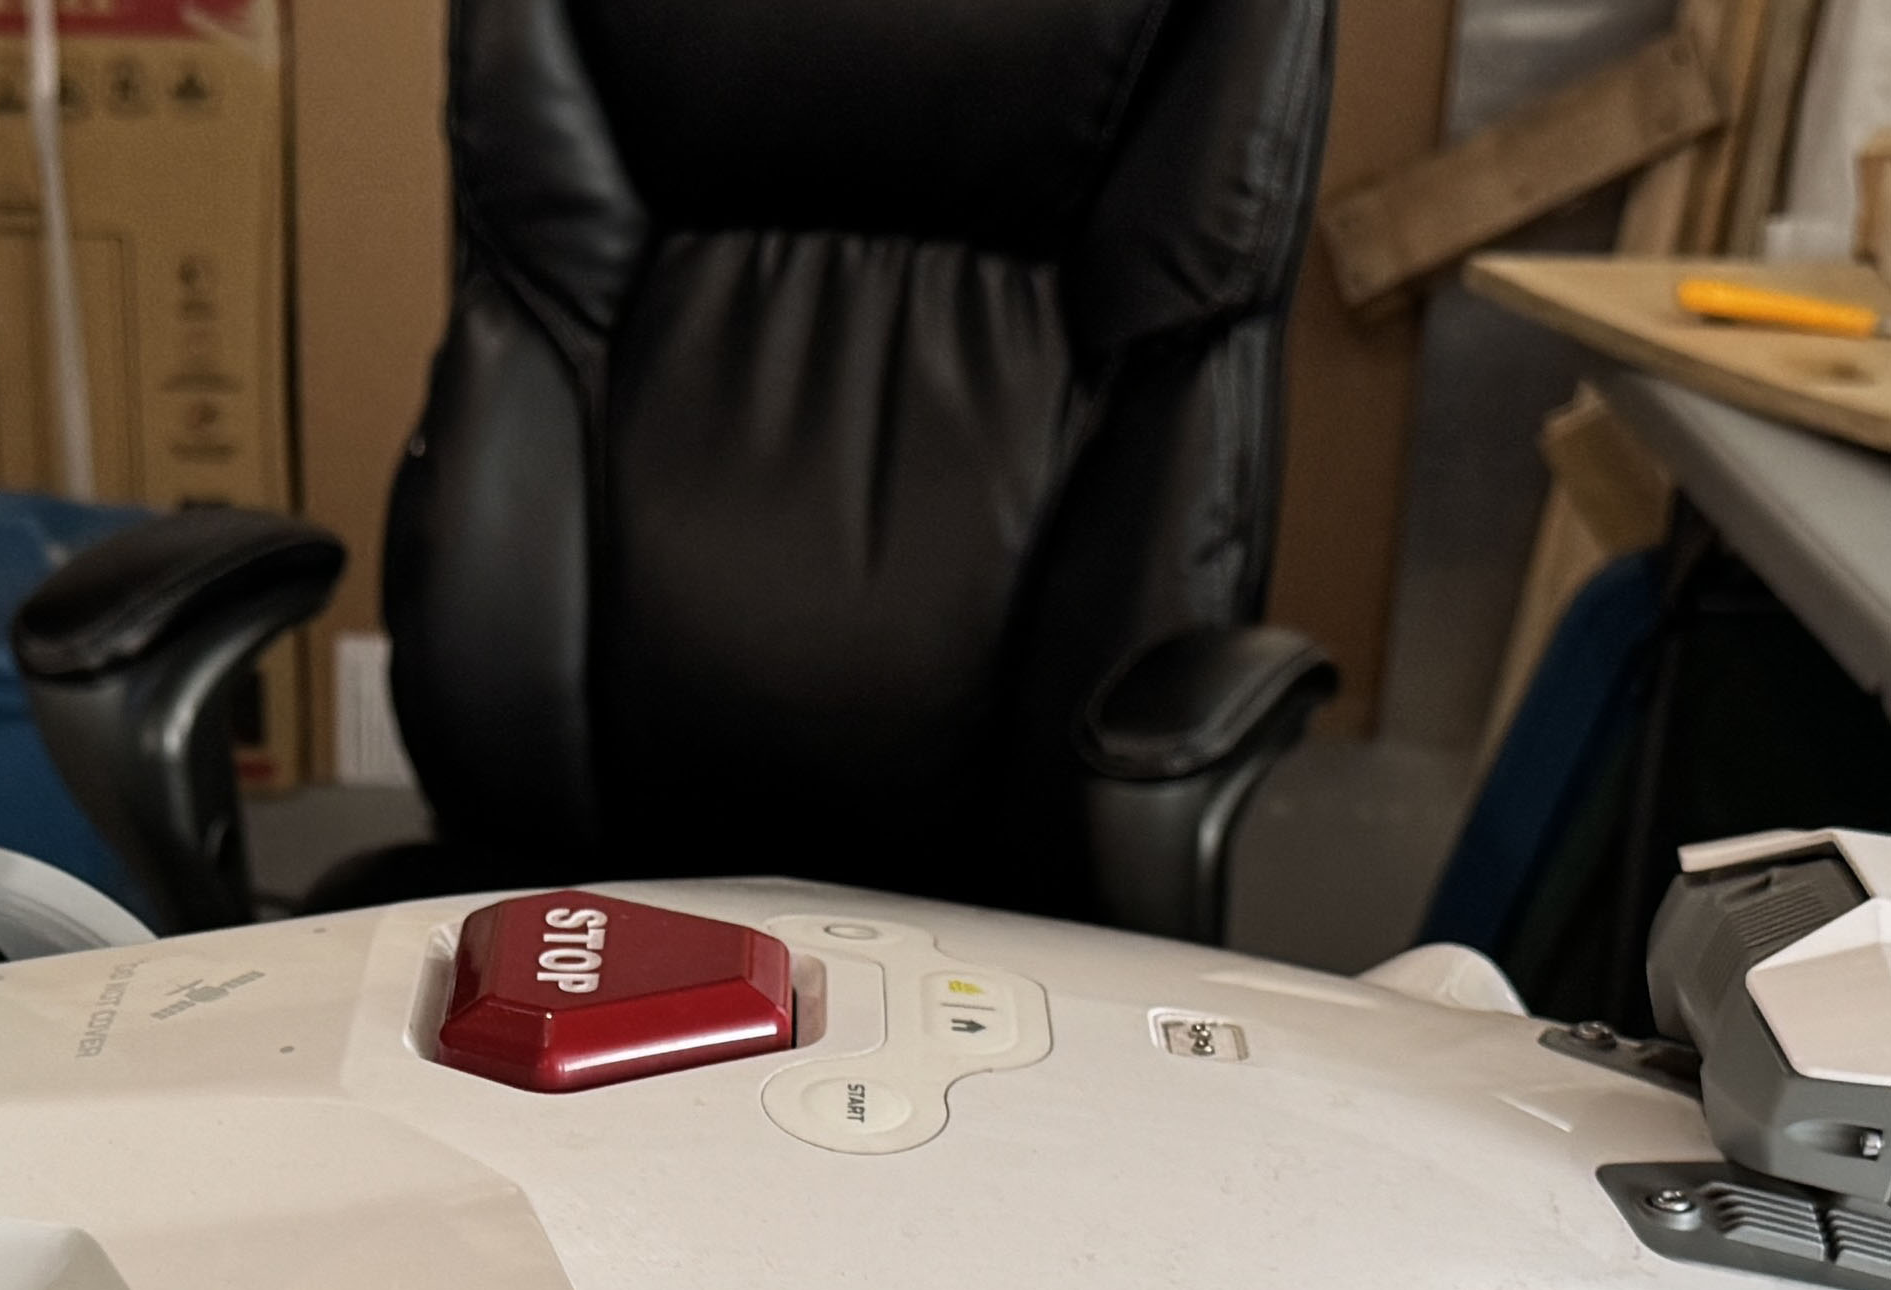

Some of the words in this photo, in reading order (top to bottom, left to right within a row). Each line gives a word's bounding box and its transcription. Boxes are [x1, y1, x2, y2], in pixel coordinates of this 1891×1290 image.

[536, 907, 608, 993] STOP
[96, 981, 130, 1007] NOT
[74, 1009, 117, 1058] COVER
[846, 1084, 865, 1123] START
